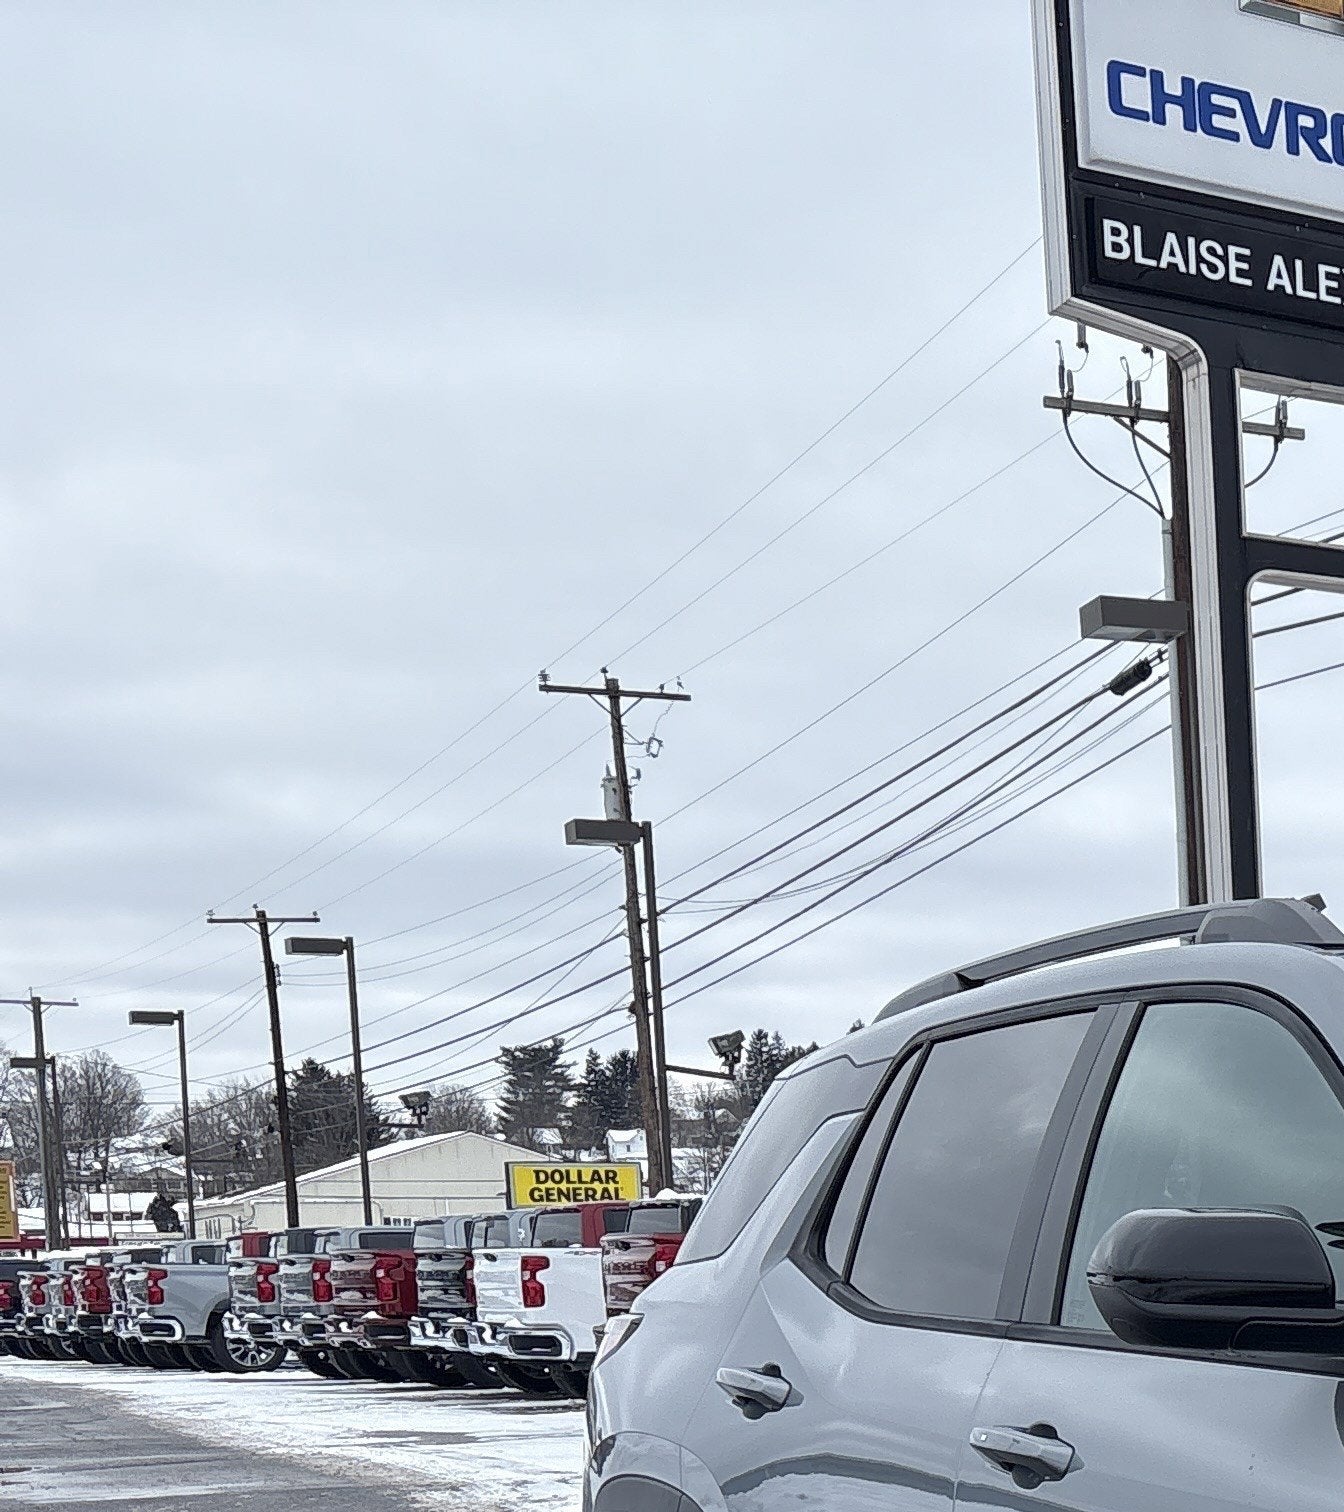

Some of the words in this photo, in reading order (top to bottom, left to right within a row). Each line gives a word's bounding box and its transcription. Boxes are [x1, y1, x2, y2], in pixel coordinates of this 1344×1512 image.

[1101, 218, 1253, 287] BLAISE
[533, 1168, 620, 1185] DOLLAR
[528, 1186, 627, 1203] GENERAL
